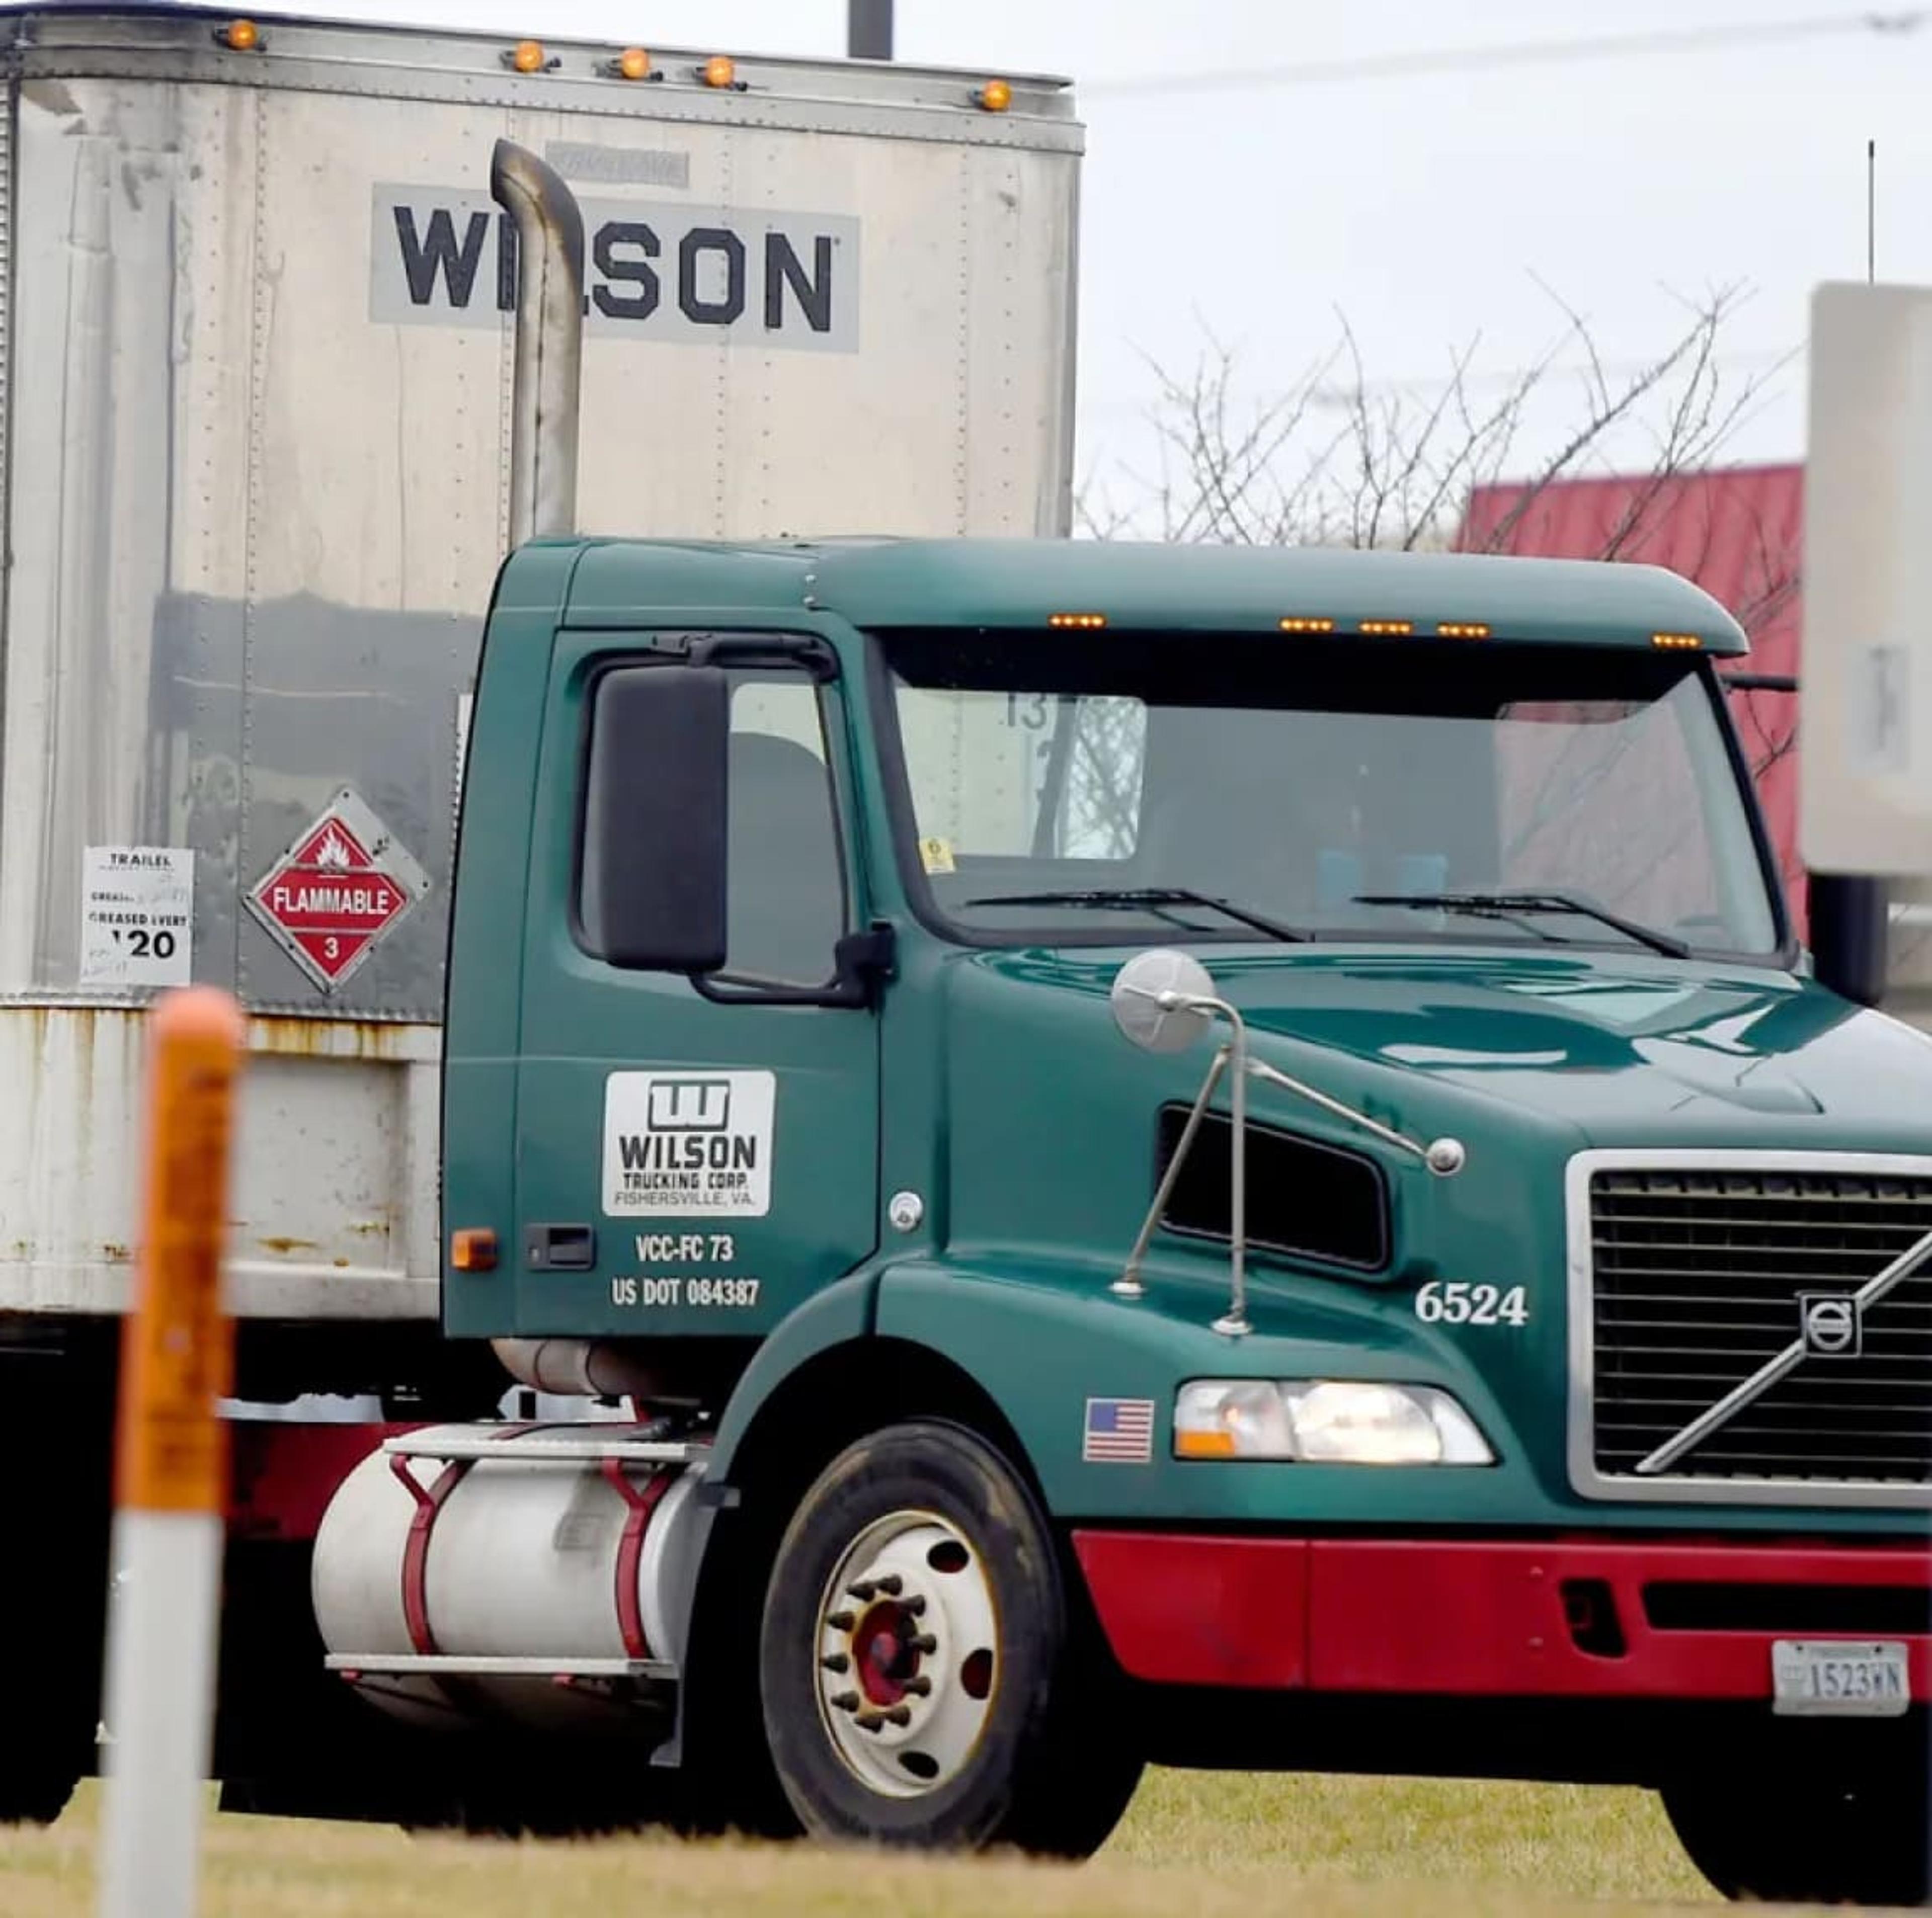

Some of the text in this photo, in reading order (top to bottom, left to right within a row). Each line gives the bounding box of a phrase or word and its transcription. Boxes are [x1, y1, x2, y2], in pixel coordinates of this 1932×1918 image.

[393, 206, 832, 332] WISON
[273, 887, 389, 915] FLAMMABLE
[112, 930, 175, 960] 20
[324, 937, 339, 959] 3
[619, 1135, 756, 1169] WILSON
[623, 1173, 699, 1190] TRUCKING
[635, 1234, 733, 1262] VCC-FC 73
[612, 1278, 760, 1305] US DOT 084387
[1415, 1281, 1530, 1326] 6524
